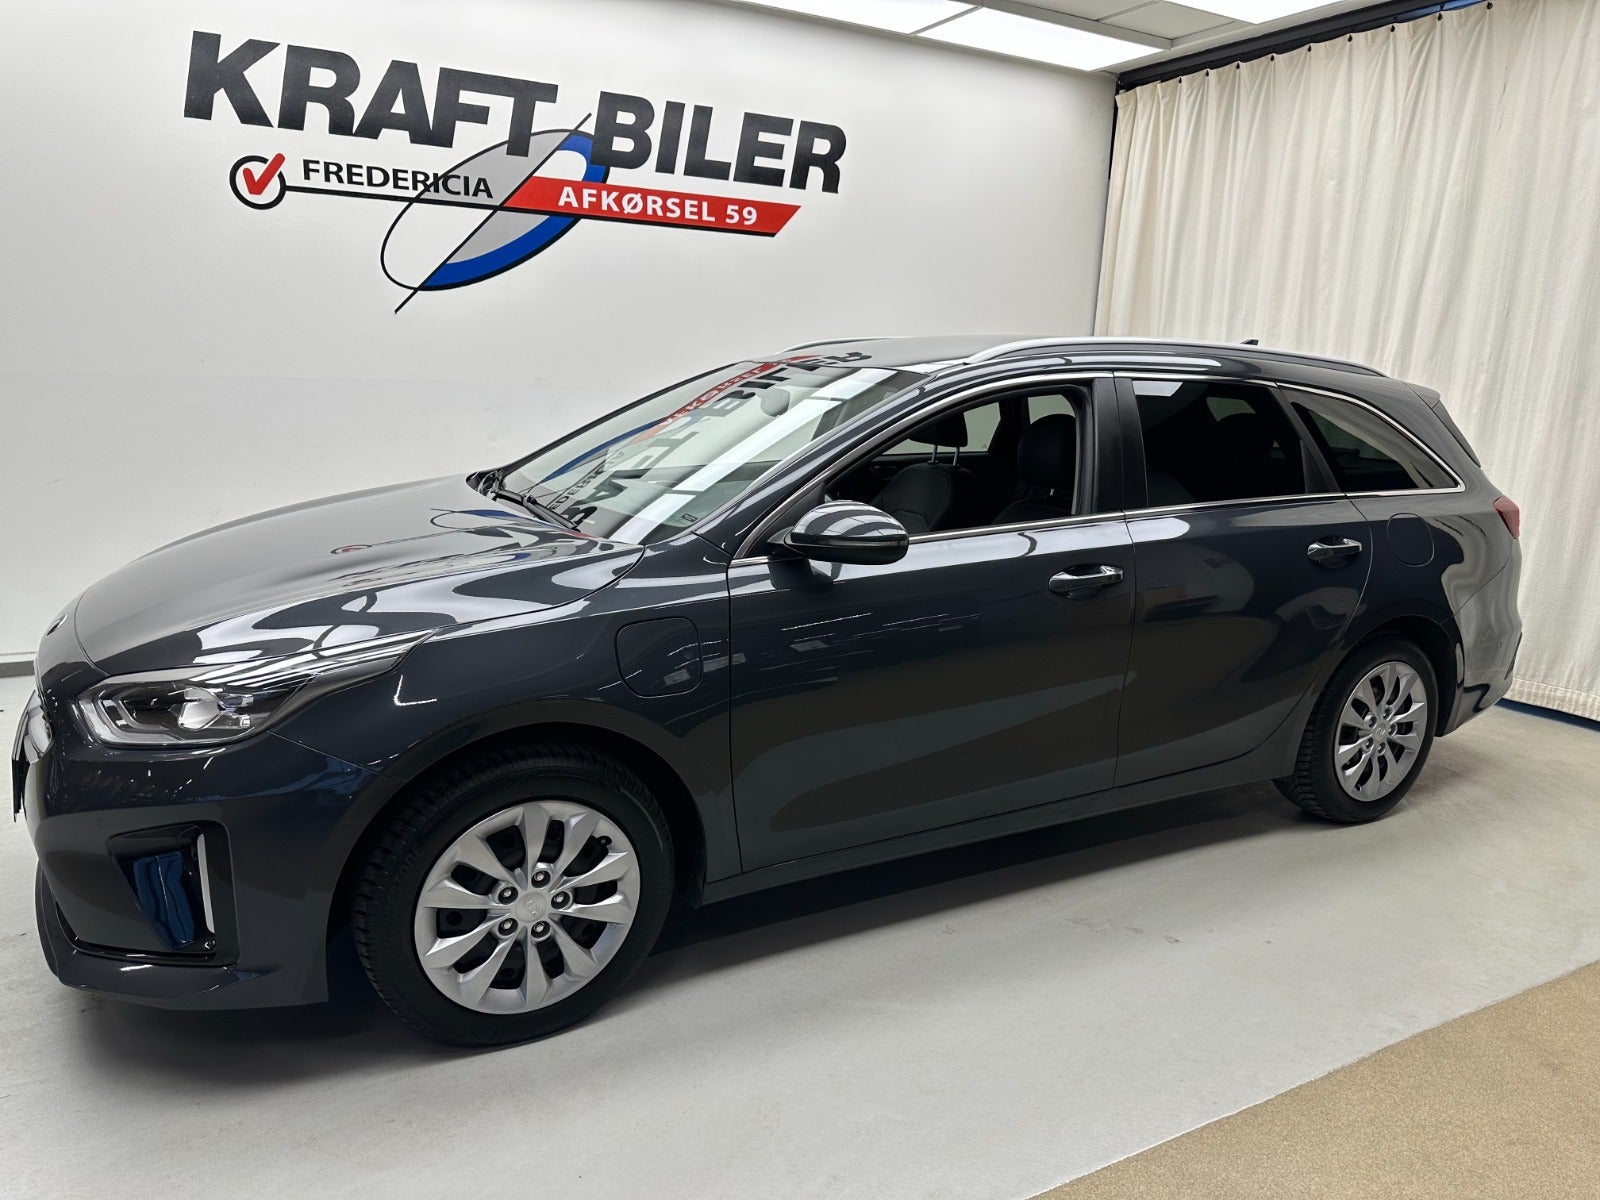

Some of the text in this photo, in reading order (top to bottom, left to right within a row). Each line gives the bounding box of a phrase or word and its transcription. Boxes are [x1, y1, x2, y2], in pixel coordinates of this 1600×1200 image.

[184, 31, 847, 193] KRAFT BILER
[303, 159, 494, 198] FREDERICIA
[559, 186, 758, 226] AFKØRSEL 59
